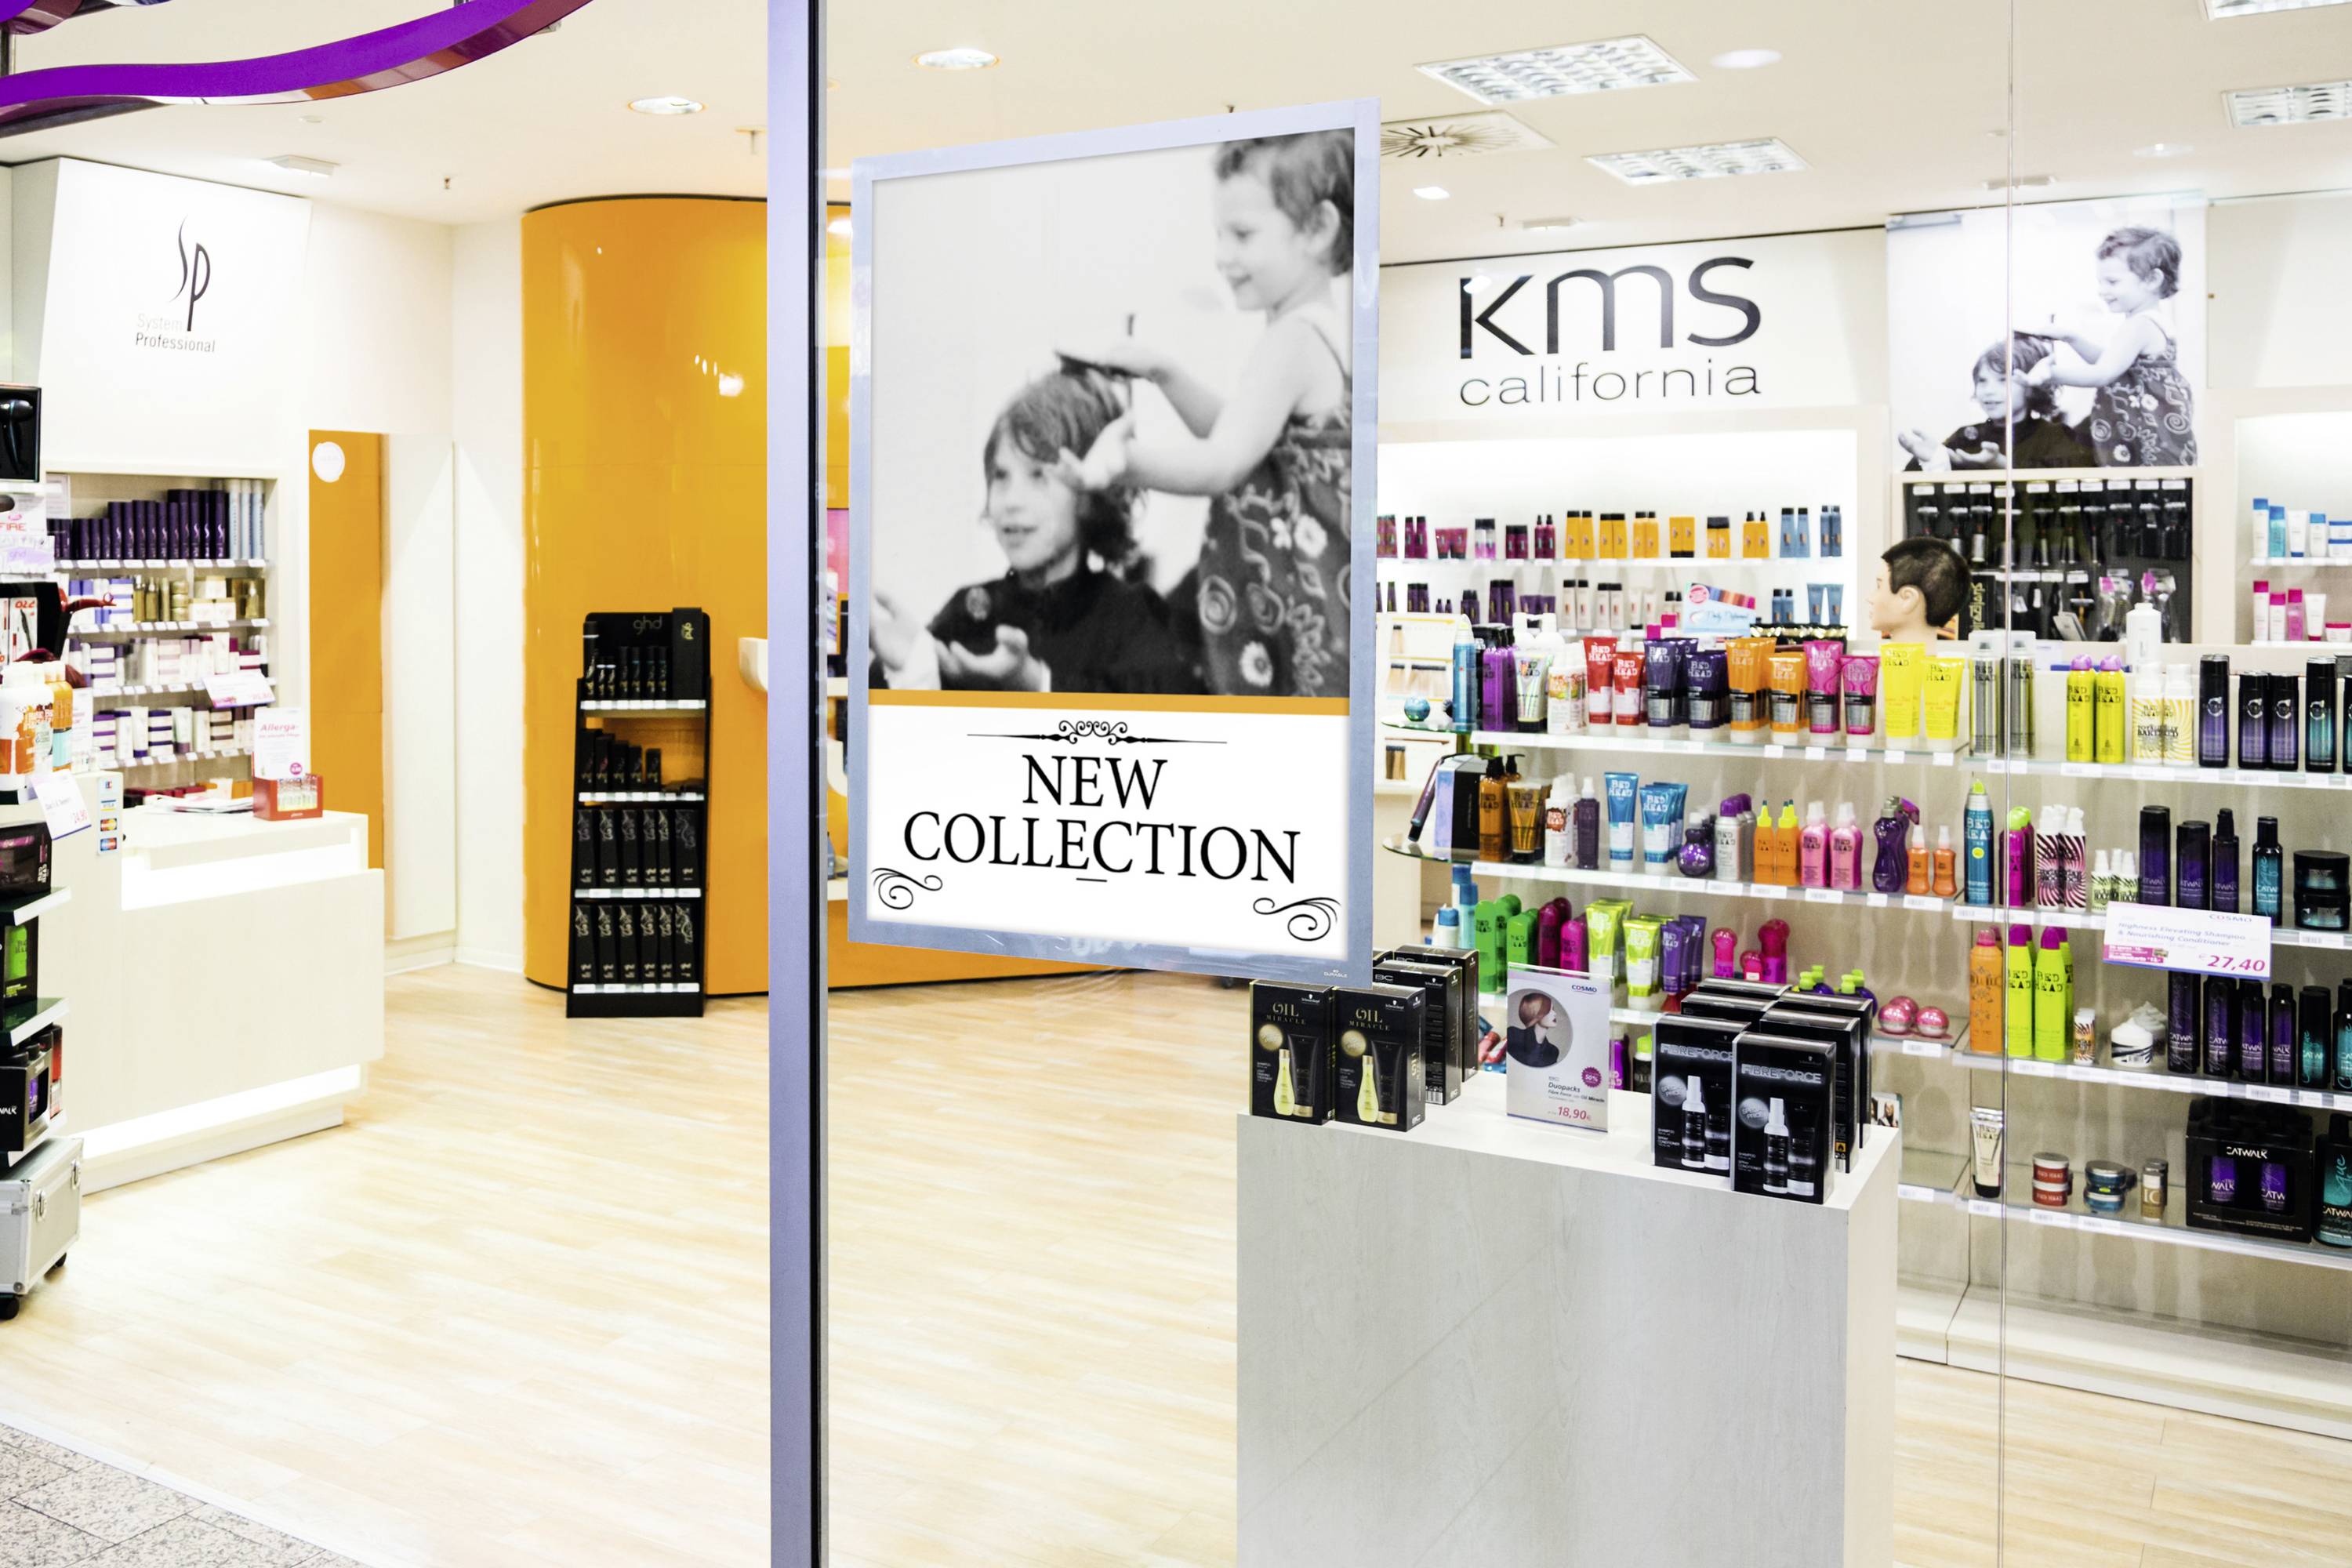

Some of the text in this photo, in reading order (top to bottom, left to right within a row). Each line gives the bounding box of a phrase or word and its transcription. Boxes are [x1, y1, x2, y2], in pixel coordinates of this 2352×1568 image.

[137, 314, 183, 331] System
[136, 332, 216, 352] Professional
[1461, 358, 1761, 405] california
[633, 615, 662, 635] ghd
[1590, 644, 1610, 654] BED
[1588, 653, 1612, 662] HEAD
[1617, 659, 1636, 668] BED
[1690, 661, 1710, 670] BED
[1614, 667, 1638, 677] HEAD
[1688, 669, 1712, 678] HEAD
[2067, 684, 2087, 694] BED
[2097, 686, 2119, 695] BED
[2067, 694, 2091, 702] HEAD
[1022, 754, 1167, 809] NEW
[1611, 779, 1631, 789] BED
[1608, 787, 1633, 797] HEAD
[1646, 794, 1666, 804] BED
[1643, 802, 1668, 812] HEAD
[1966, 817, 1991, 829] BED
[904, 811, 1301, 884] COLLECTION
[2209, 914, 2252, 923] COSMO
[2126, 931, 2175, 942] Nourishing
[2177, 935, 2231, 946] Conditioner
[2160, 927, 2201, 937] Elevating
[2205, 931, 2246, 941] Shampoo
[2207, 955, 2266, 972] 27,40
[2037, 971, 2060, 982] BED
[1571, 984, 1598, 993] COSMO
[2009, 981, 2031, 989] EAD
[2035, 982, 2063, 993] HEAD
[1272, 1003, 1299, 1017] OIL
[1266, 1014, 1306, 1025] MIRACLE
[1356, 1008, 1382, 1024] OIL
[1349, 1020, 1391, 1031] MIRACLE
[1740, 1063, 1823, 1083] FIBREFORCE
[1548, 1082, 1581, 1093] Duopacks
[2226, 1146, 2268, 1159] CATWALK
